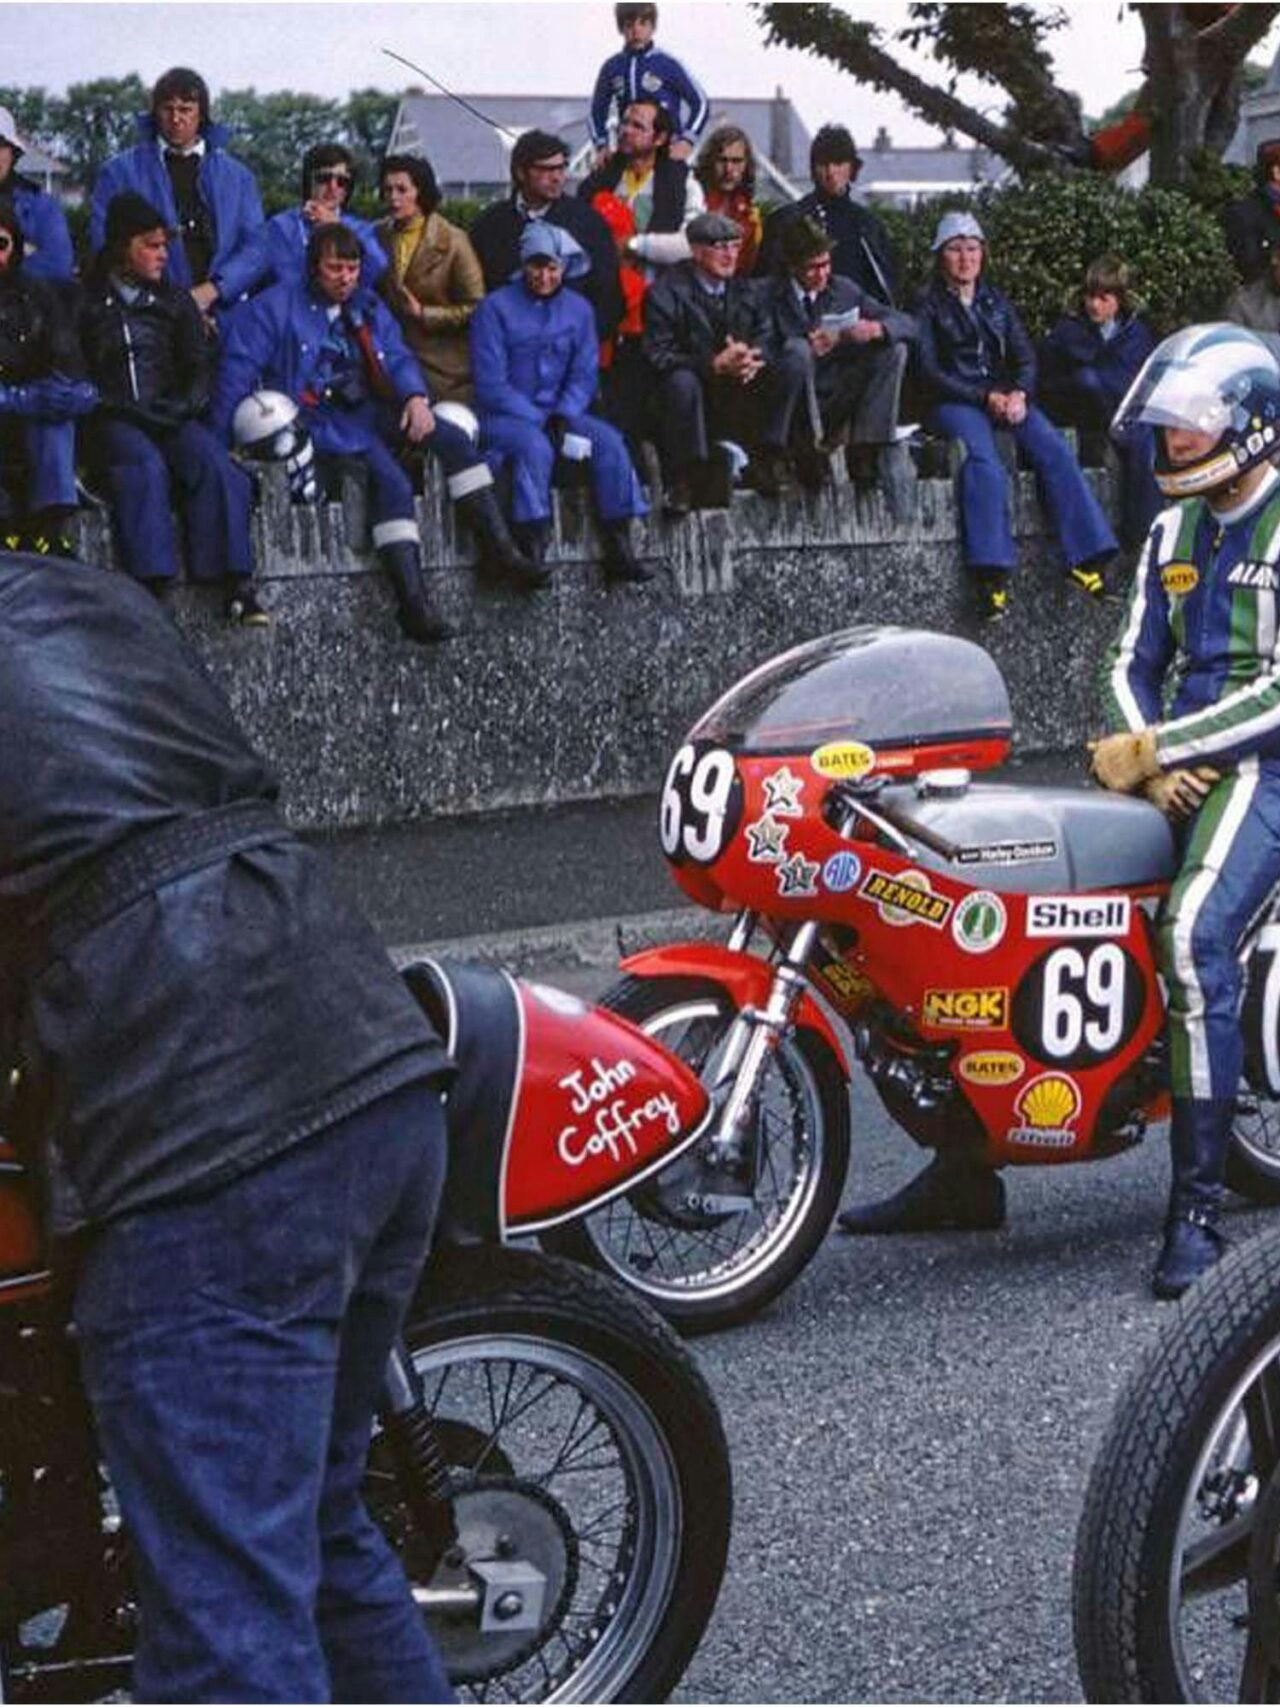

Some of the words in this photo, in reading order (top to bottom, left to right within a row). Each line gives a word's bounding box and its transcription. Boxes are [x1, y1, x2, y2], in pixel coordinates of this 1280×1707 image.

[818, 751, 870, 768] BATES
[660, 744, 735, 863] 69
[868, 877, 946, 920] RENOLD
[1032, 902, 1125, 929] Shell
[930, 991, 1002, 1019] NGK
[1042, 942, 1126, 1058] 69
[966, 1061, 1019, 1074] BATES
[558, 1058, 638, 1115] John
